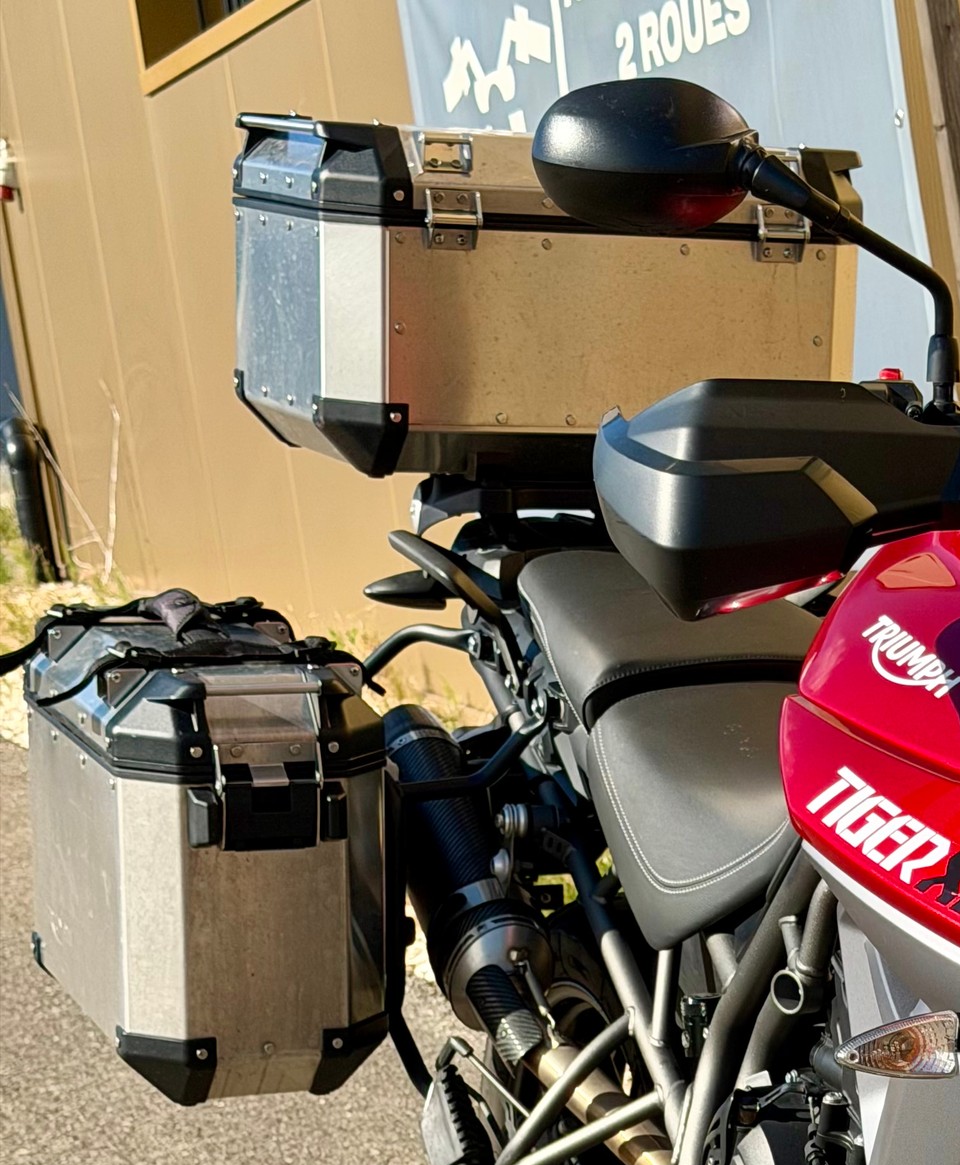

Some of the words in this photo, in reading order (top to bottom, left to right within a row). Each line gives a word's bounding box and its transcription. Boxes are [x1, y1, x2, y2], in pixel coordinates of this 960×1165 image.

[615, 21, 638, 81] 2
[638, 0, 751, 73] ROUES
[805, 765, 952, 886] TIGER
